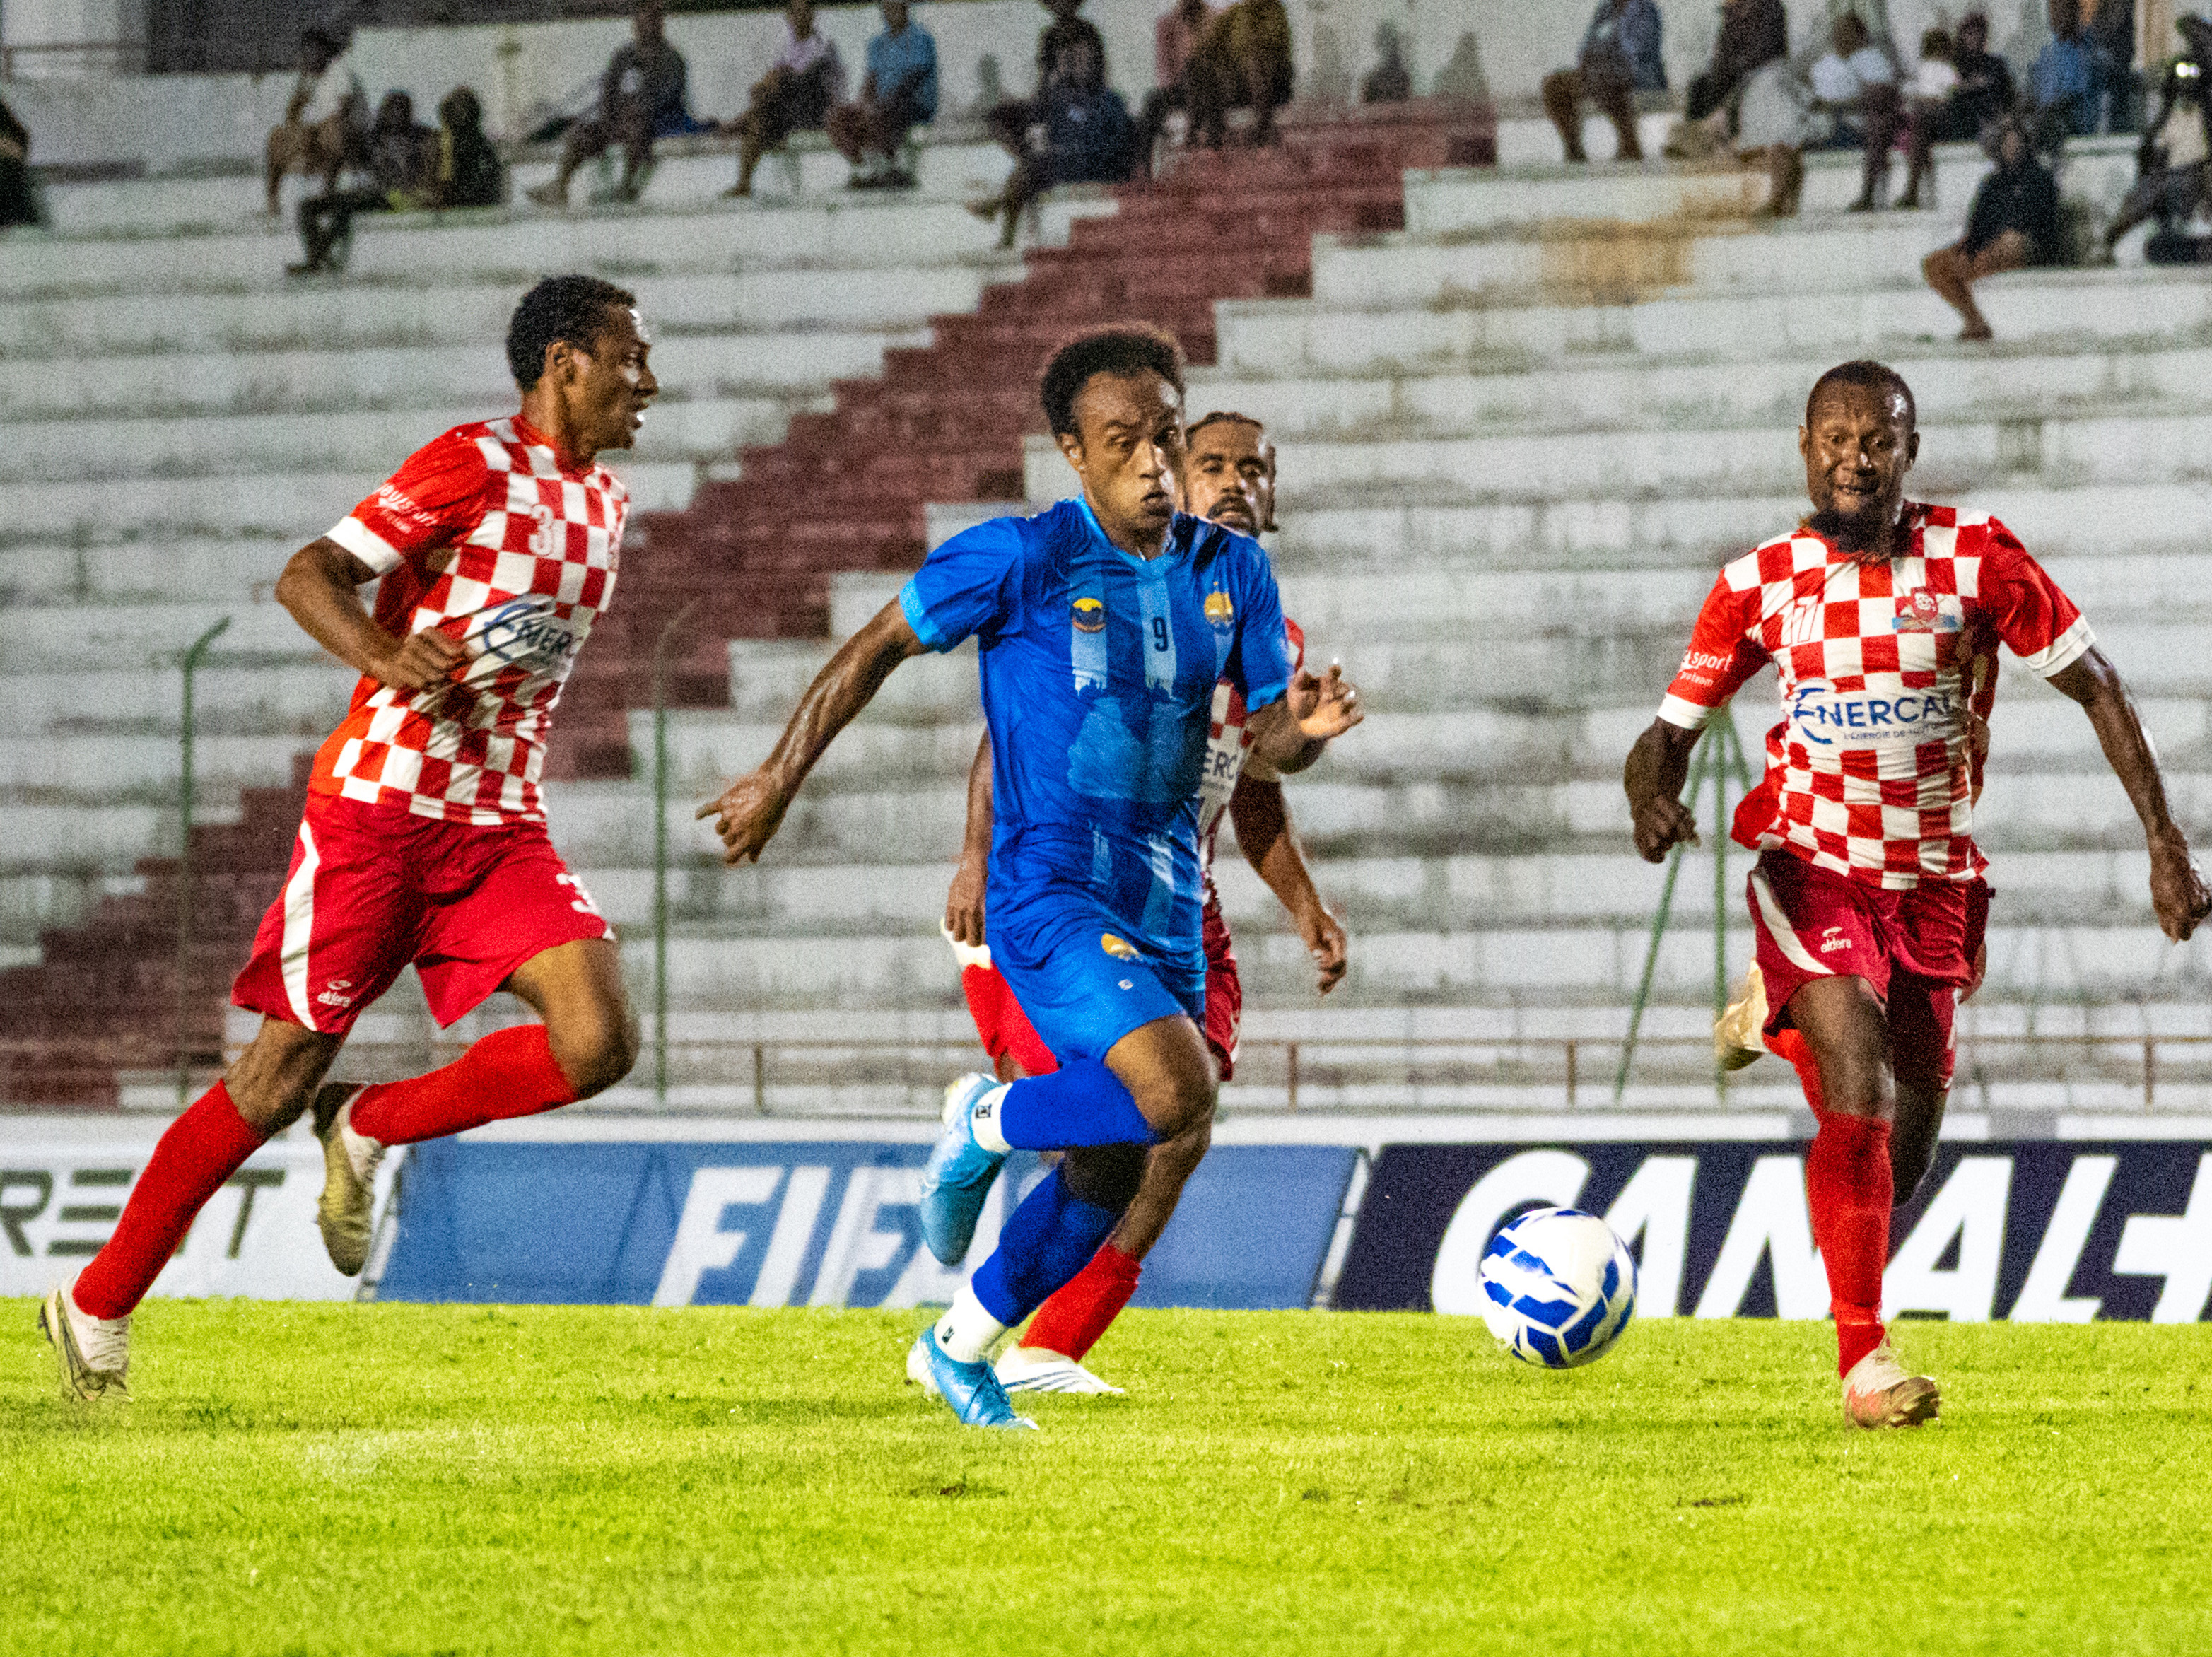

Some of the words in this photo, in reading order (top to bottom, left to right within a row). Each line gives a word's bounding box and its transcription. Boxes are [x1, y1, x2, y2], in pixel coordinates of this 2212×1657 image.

[529, 503, 555, 556] 3
[1152, 616, 1169, 652] 9
[0, 1169, 287, 1258] RET
